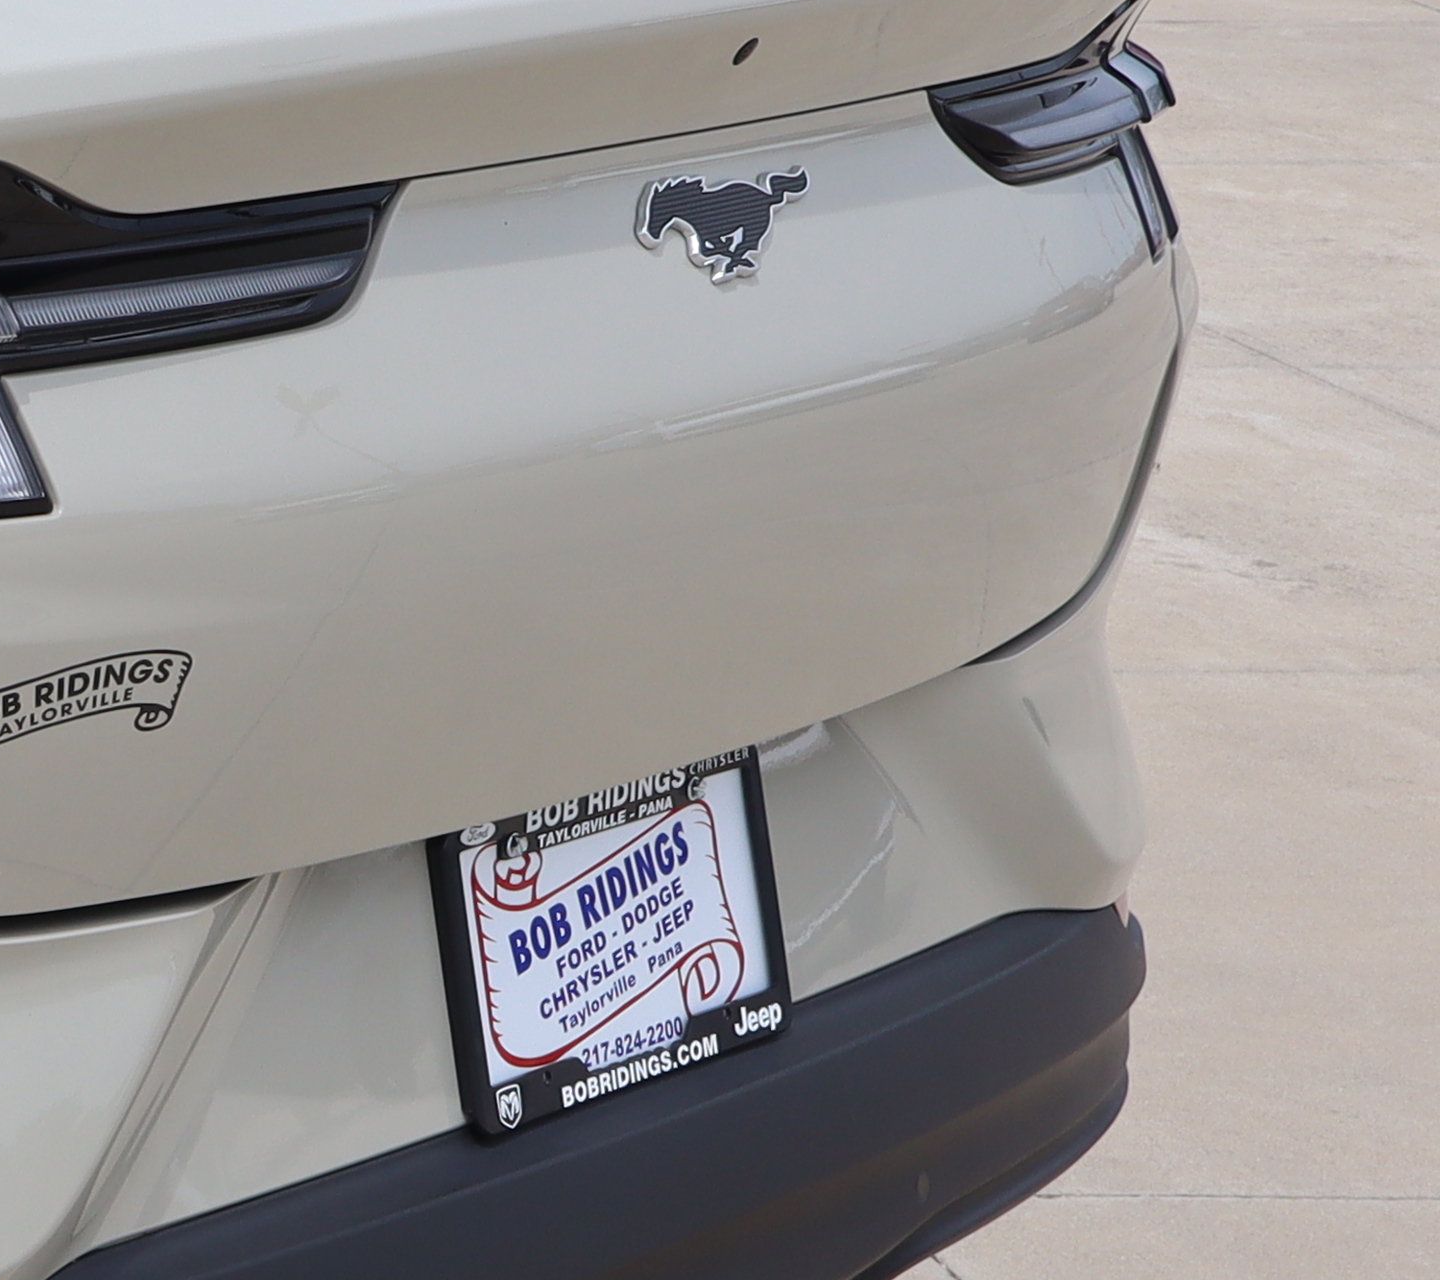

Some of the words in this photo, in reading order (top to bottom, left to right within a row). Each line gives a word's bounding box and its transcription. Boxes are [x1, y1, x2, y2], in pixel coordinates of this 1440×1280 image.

[35, 658, 173, 708] RIDINGS
[689, 747, 750, 775] CHRYSLER
[526, 801, 578, 833] BOB
[588, 768, 686, 815] RIDINGS
[538, 810, 626, 849] TAYLORVILLE
[638, 796, 673, 817] PANA
[508, 903, 572, 976] BOB
[577, 821, 689, 930] RIDINGS
[555, 931, 607, 979] FORD
[621, 877, 684, 934] DODGE
[540, 940, 638, 1019] CHRYSLER
[653, 899, 694, 944] JEEP
[559, 973, 637, 1033] Taylorville
[648, 941, 683, 974] Pana
[582, 1015, 683, 1069] 217-824-2200
[734, 1001, 782, 1036] Jeep
[561, 1034, 719, 1108] BOBRIDINGS.COM
